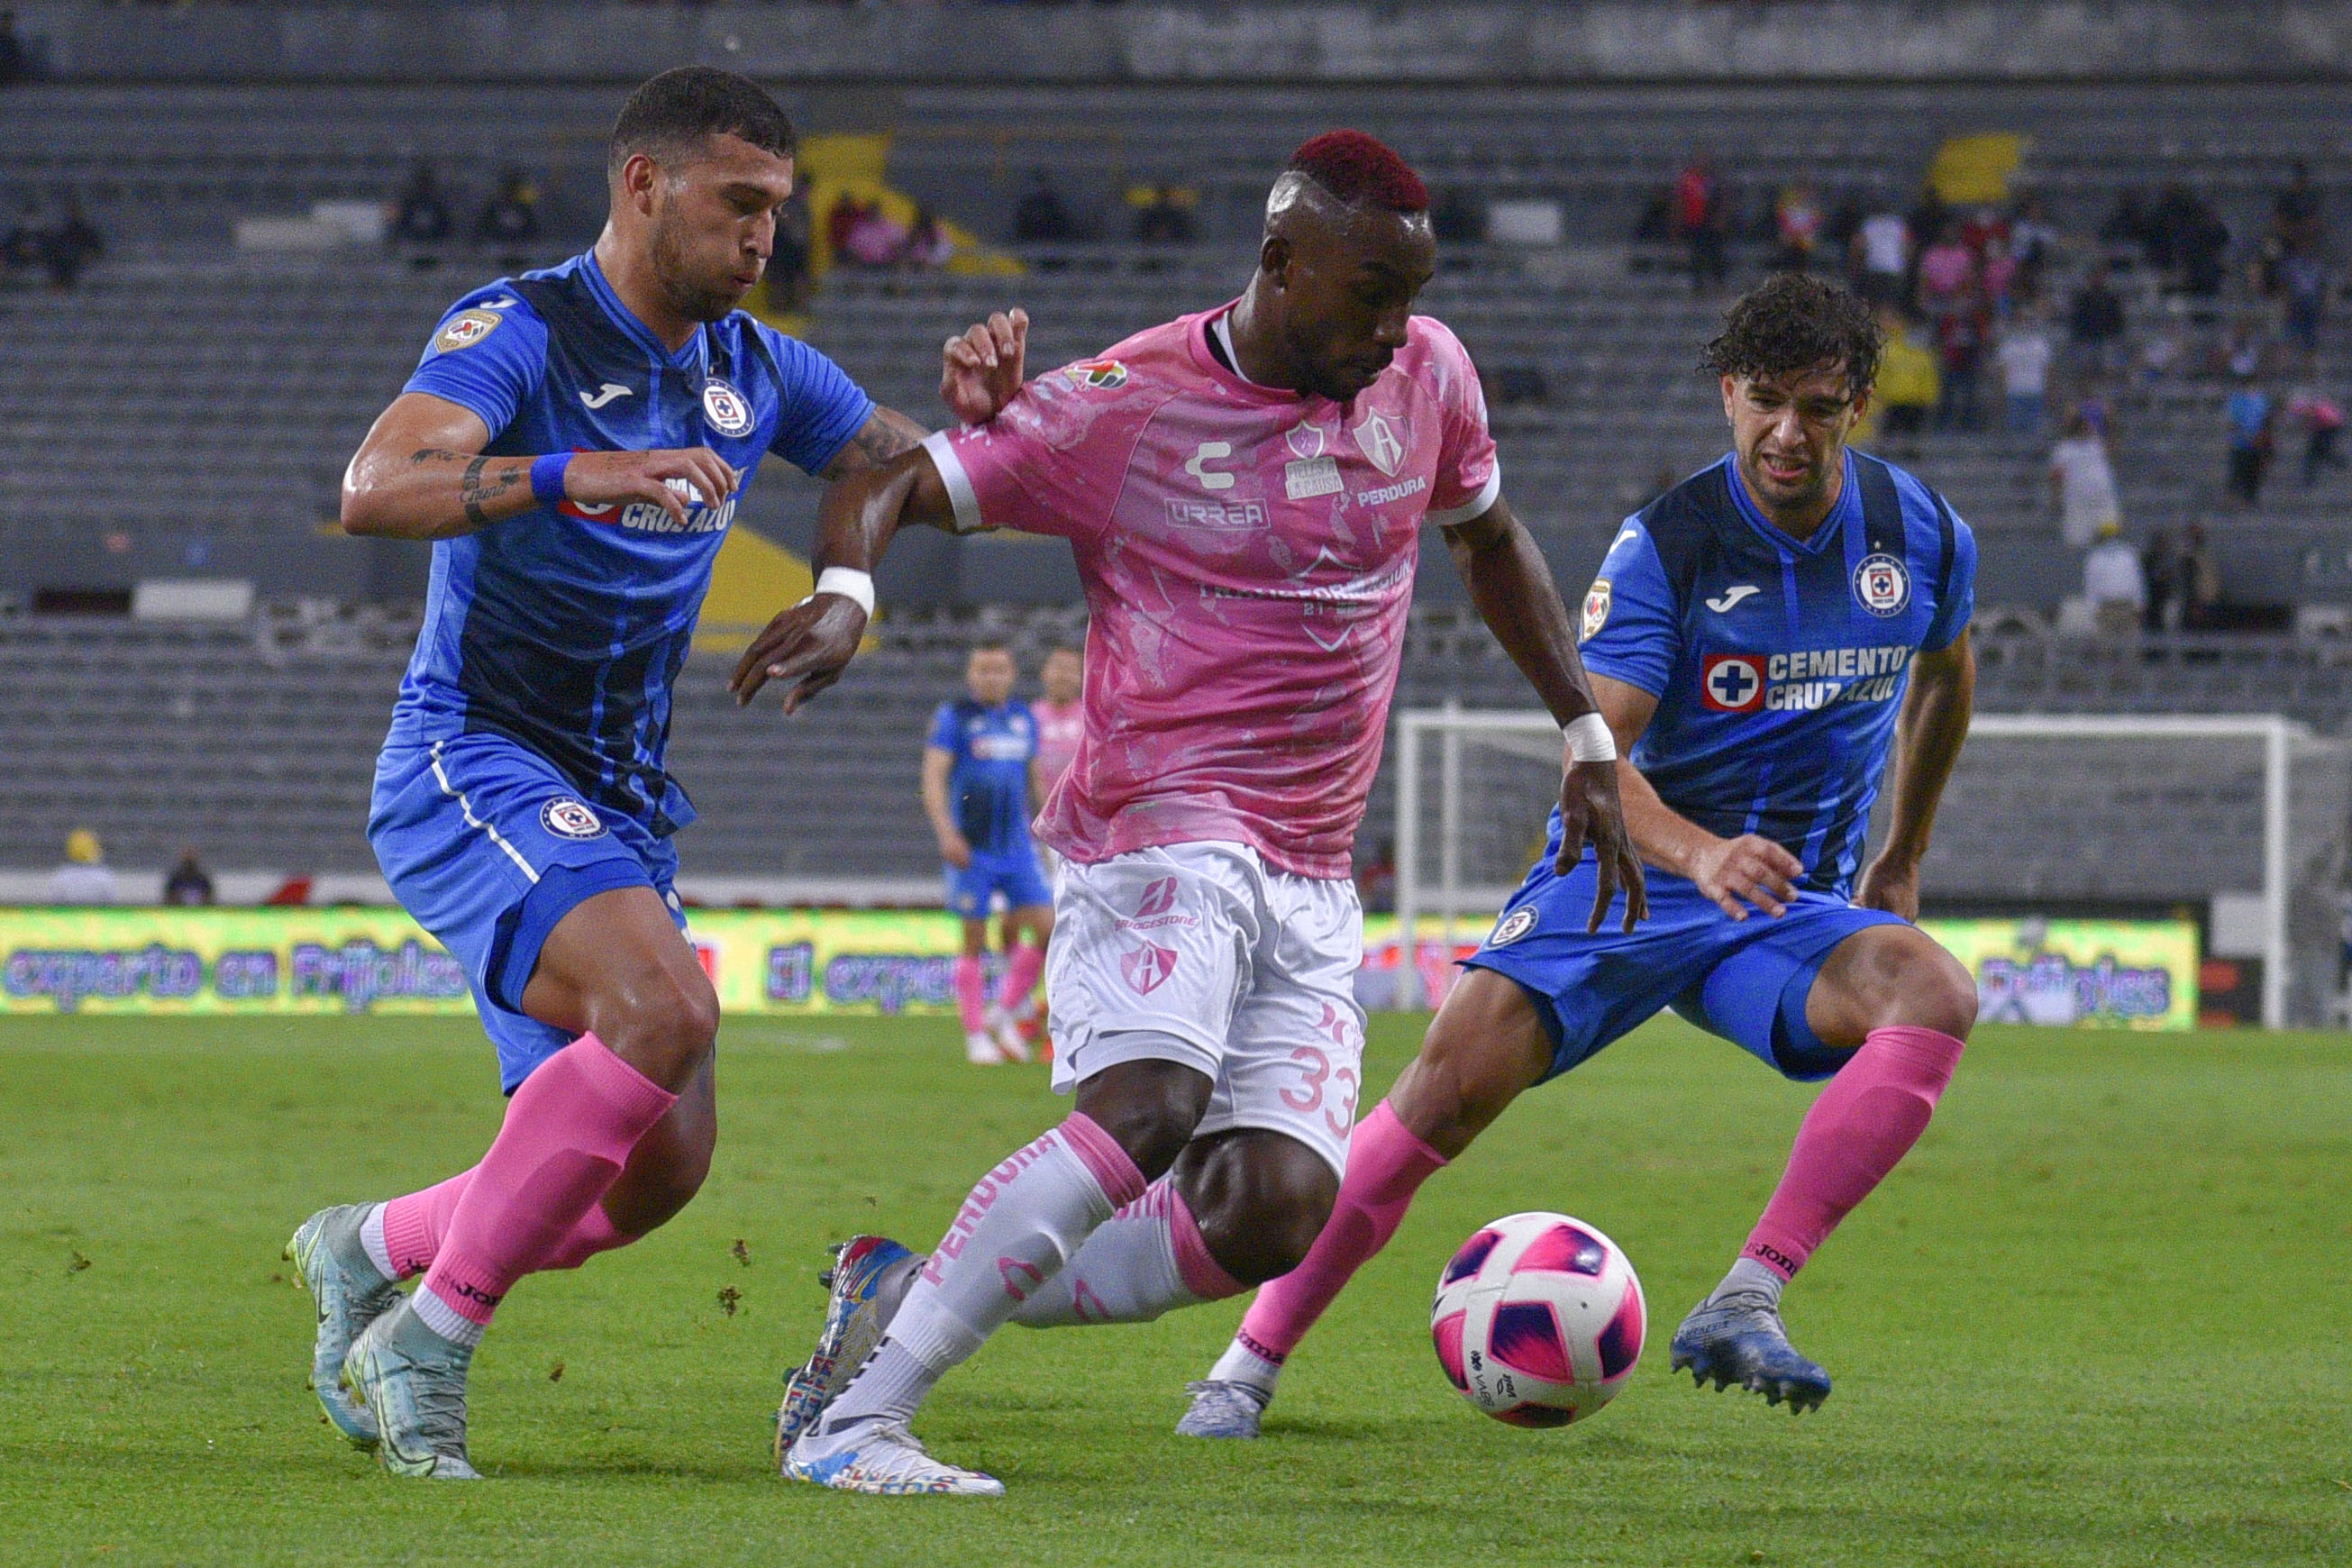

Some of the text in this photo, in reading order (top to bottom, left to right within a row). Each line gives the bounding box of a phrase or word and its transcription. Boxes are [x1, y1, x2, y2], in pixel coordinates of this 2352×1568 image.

[1357, 476, 1427, 507] PERDURA
[1171, 504, 1264, 526] URREA
[1768, 644, 1910, 681] CEMENTO
[1765, 675, 1898, 711] CRUZ AZUL
[1114, 915, 1199, 932] BRIDGESTONE
[1280, 1046, 1357, 1142] 33
